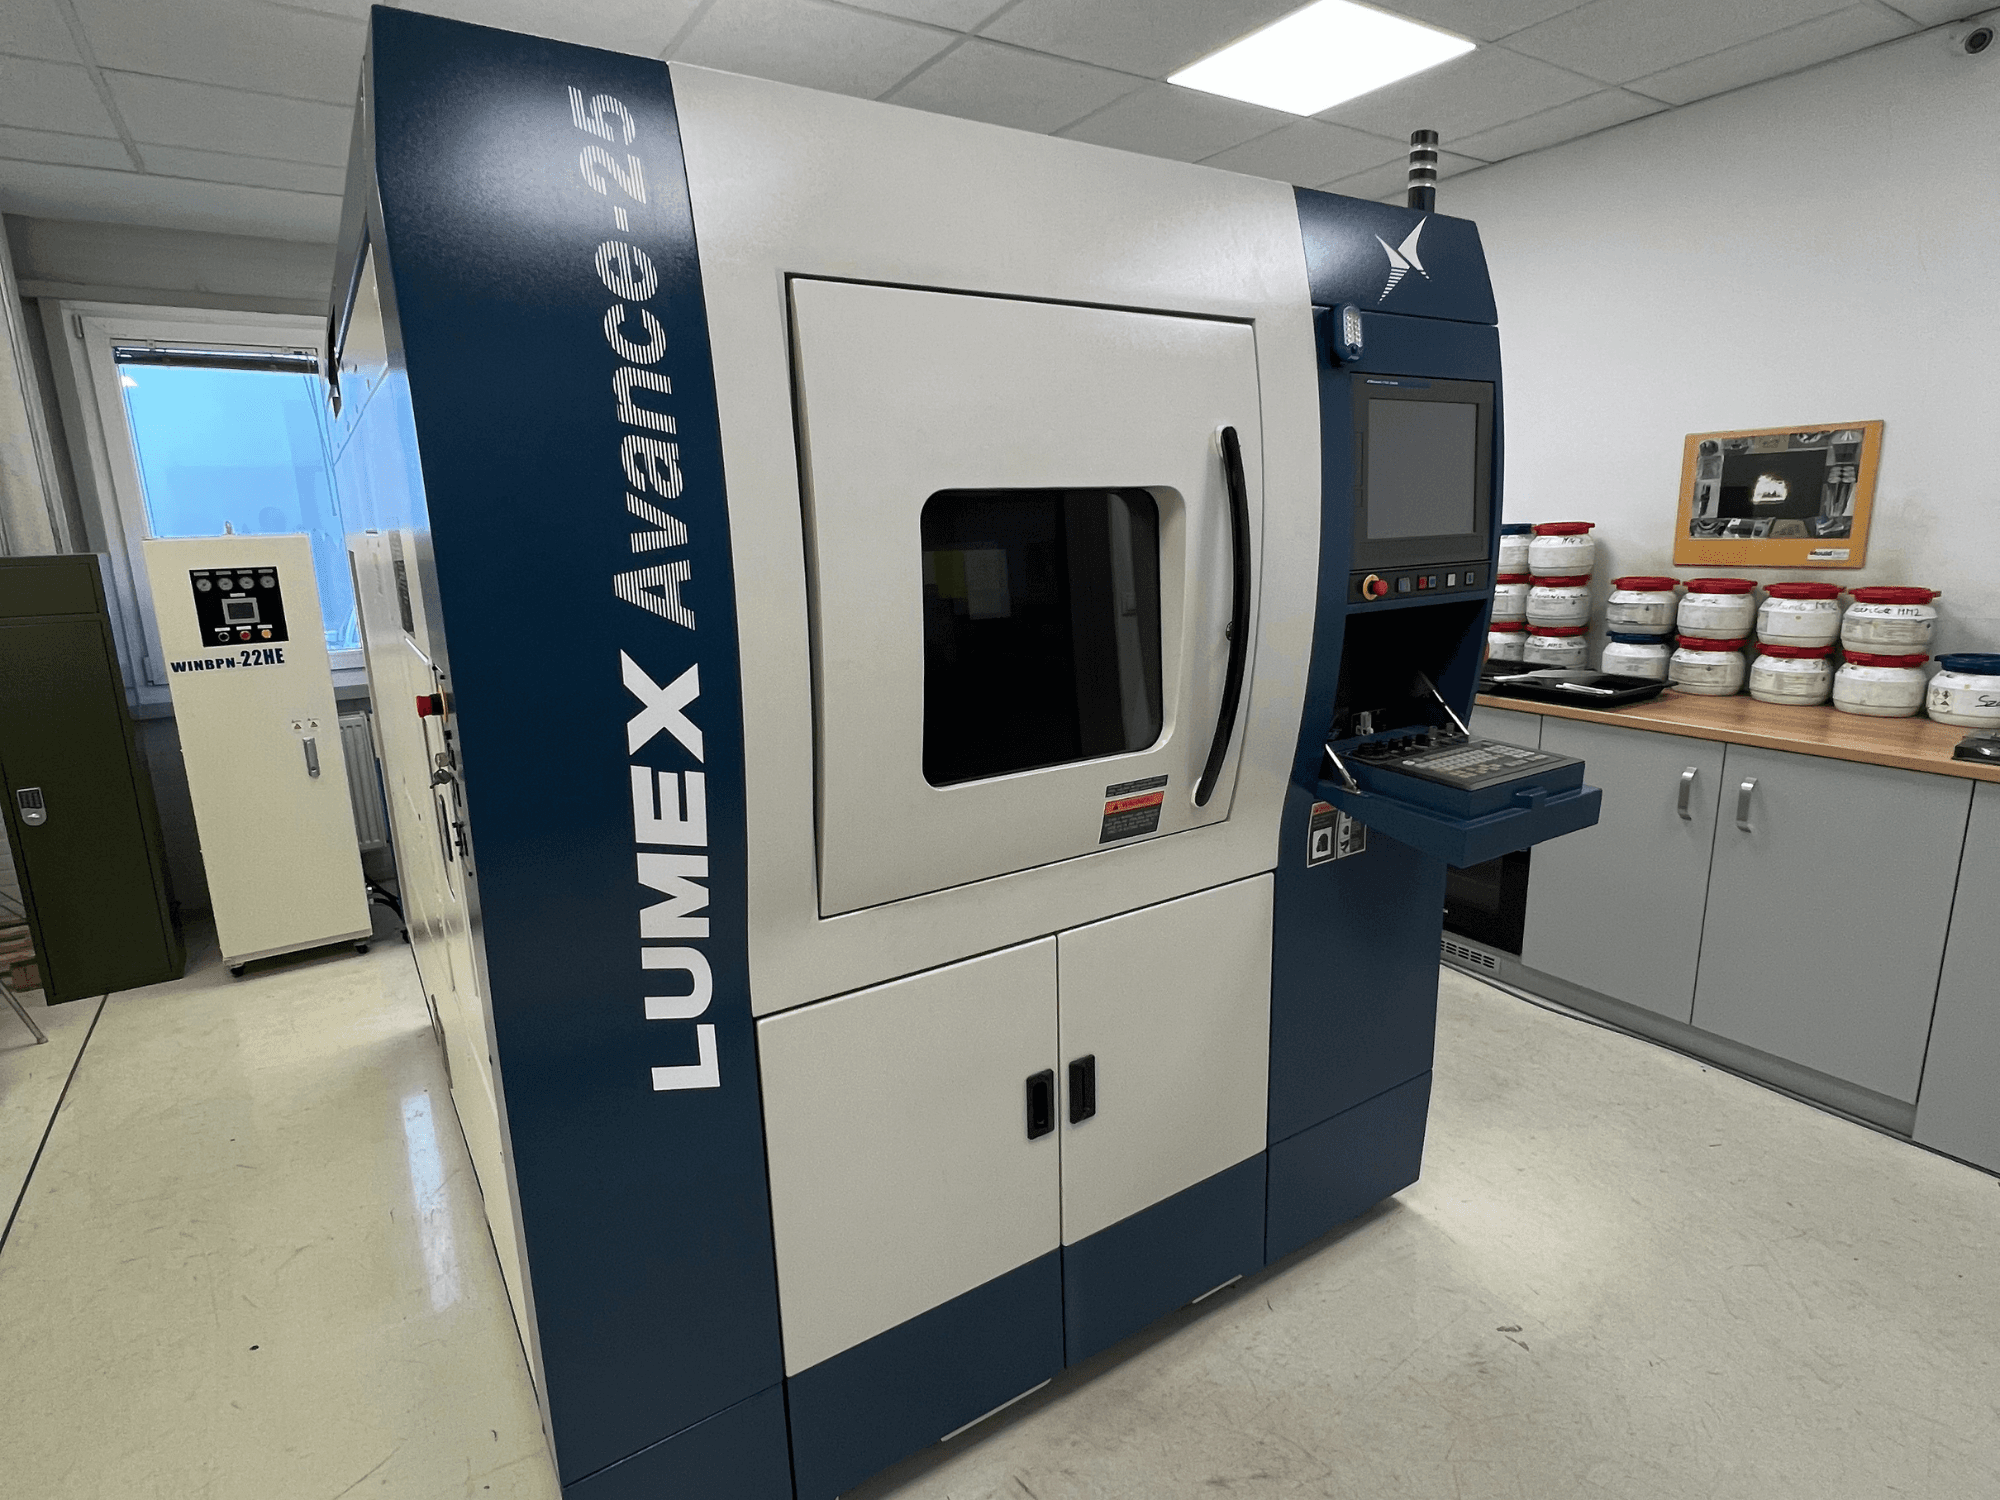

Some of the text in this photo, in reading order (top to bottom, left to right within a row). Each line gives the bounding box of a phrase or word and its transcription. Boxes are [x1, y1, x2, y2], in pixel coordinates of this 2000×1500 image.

[171, 648, 285, 672] WINBPN-22HE
[568, 85, 720, 1091] LUMEX Avance-25
